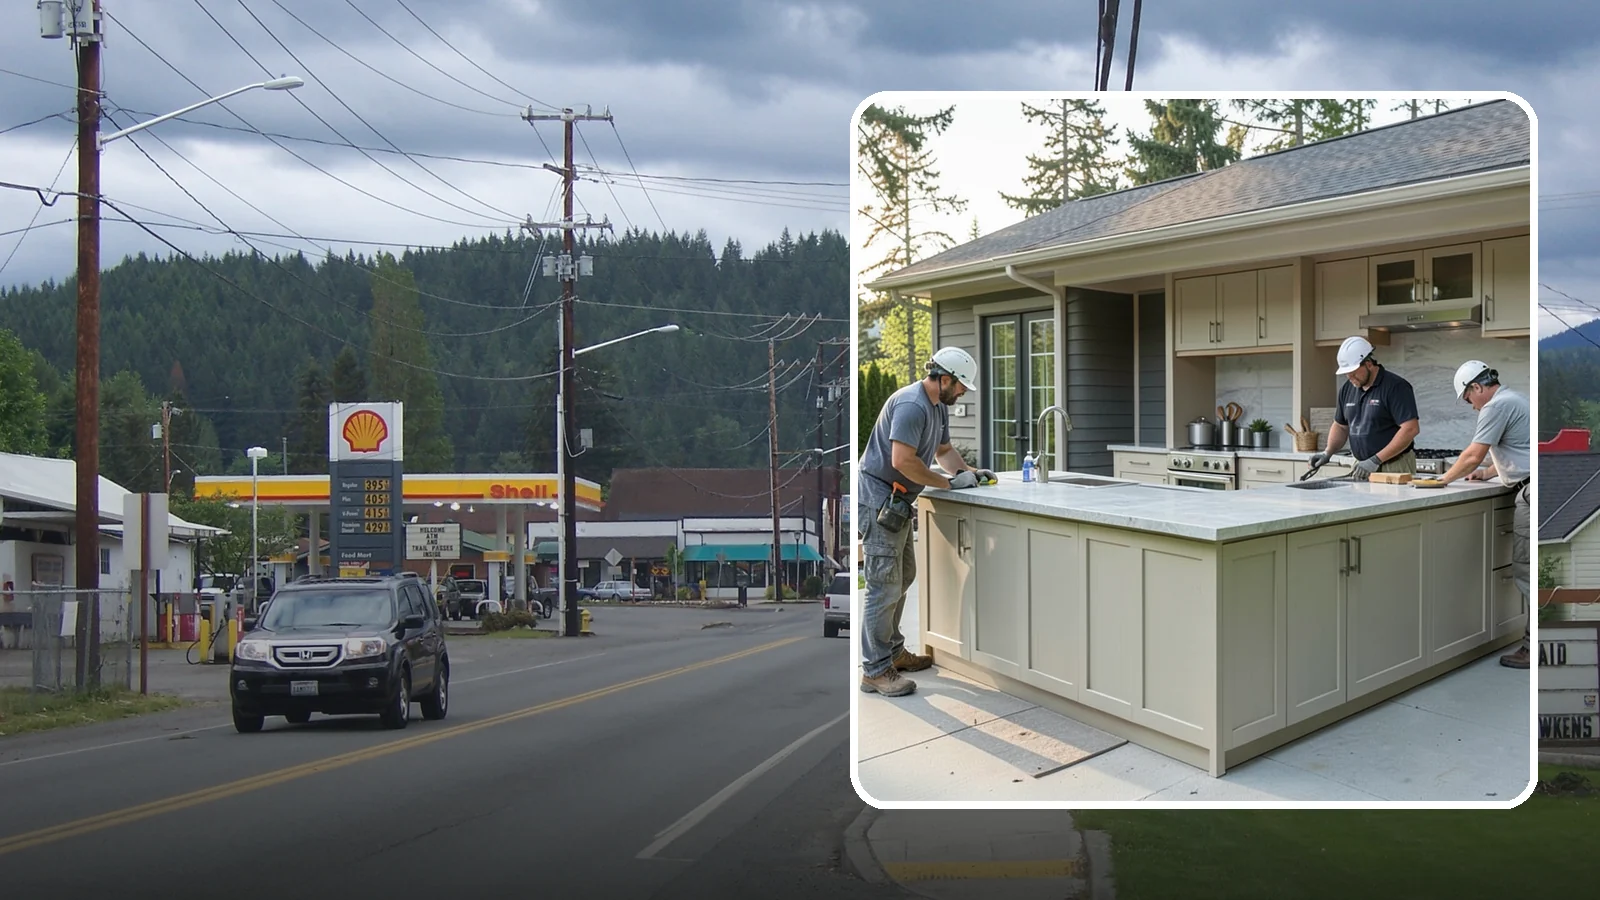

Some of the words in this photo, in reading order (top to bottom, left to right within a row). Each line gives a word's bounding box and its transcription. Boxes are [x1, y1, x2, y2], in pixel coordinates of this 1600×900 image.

[365, 480, 383, 490] 395
[490, 484, 547, 499] Shell
[365, 494, 383, 504] 405
[365, 508, 383, 518] 415
[365, 522, 383, 532] 429
